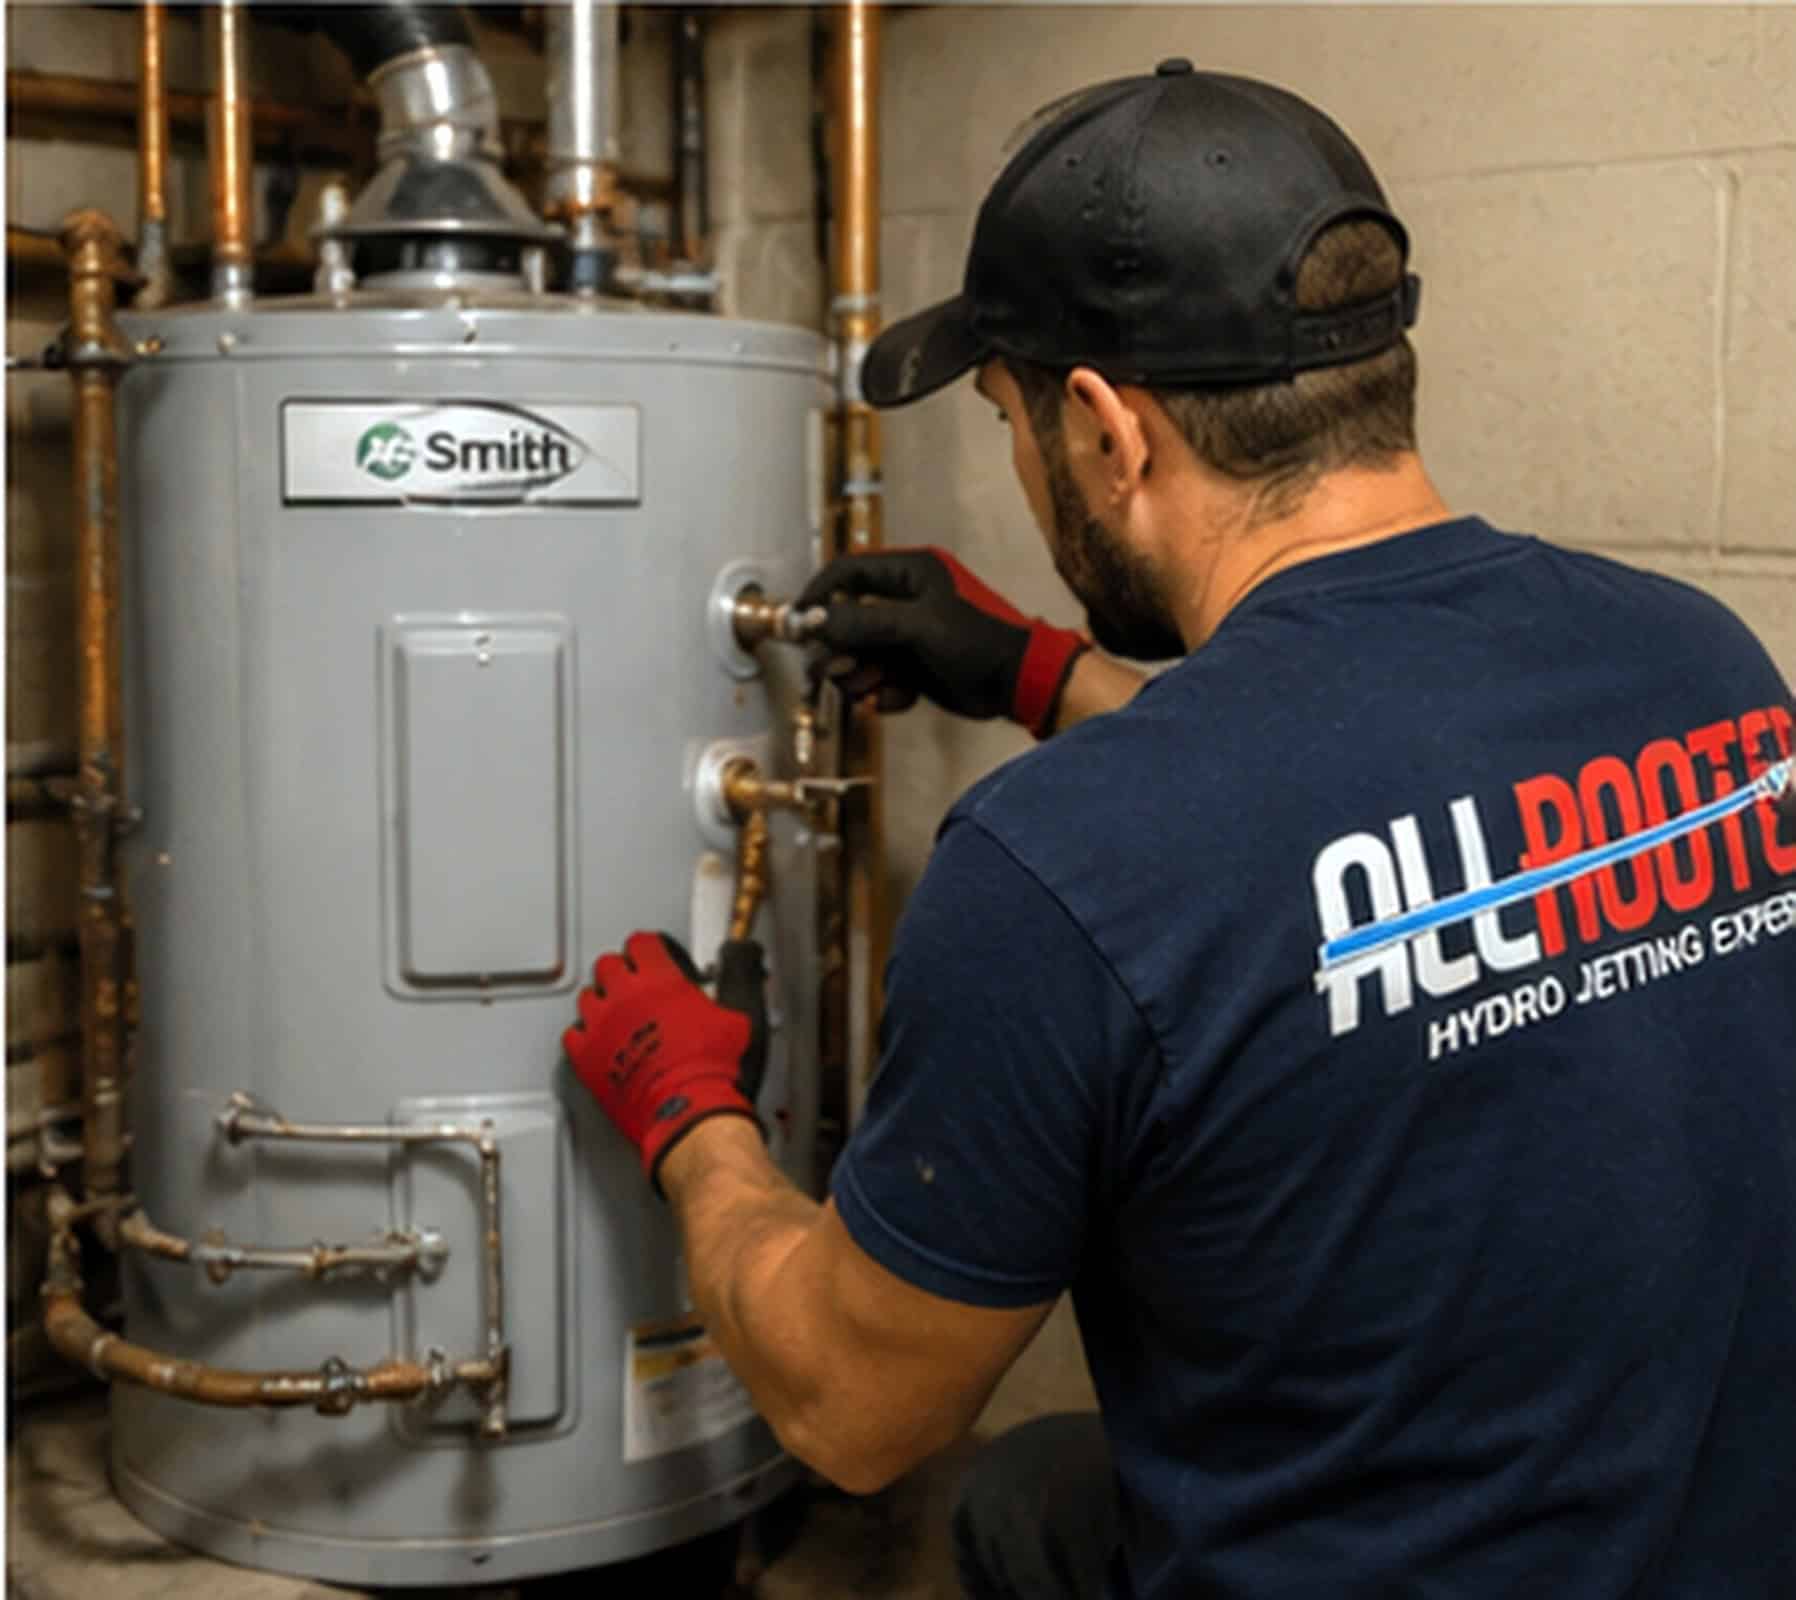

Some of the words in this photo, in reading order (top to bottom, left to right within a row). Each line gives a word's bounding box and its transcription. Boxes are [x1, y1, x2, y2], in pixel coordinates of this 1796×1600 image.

[425, 429, 571, 473] Smith
[1428, 976, 1567, 1060] HYDRO
[1575, 925, 1706, 1004] JETTING
